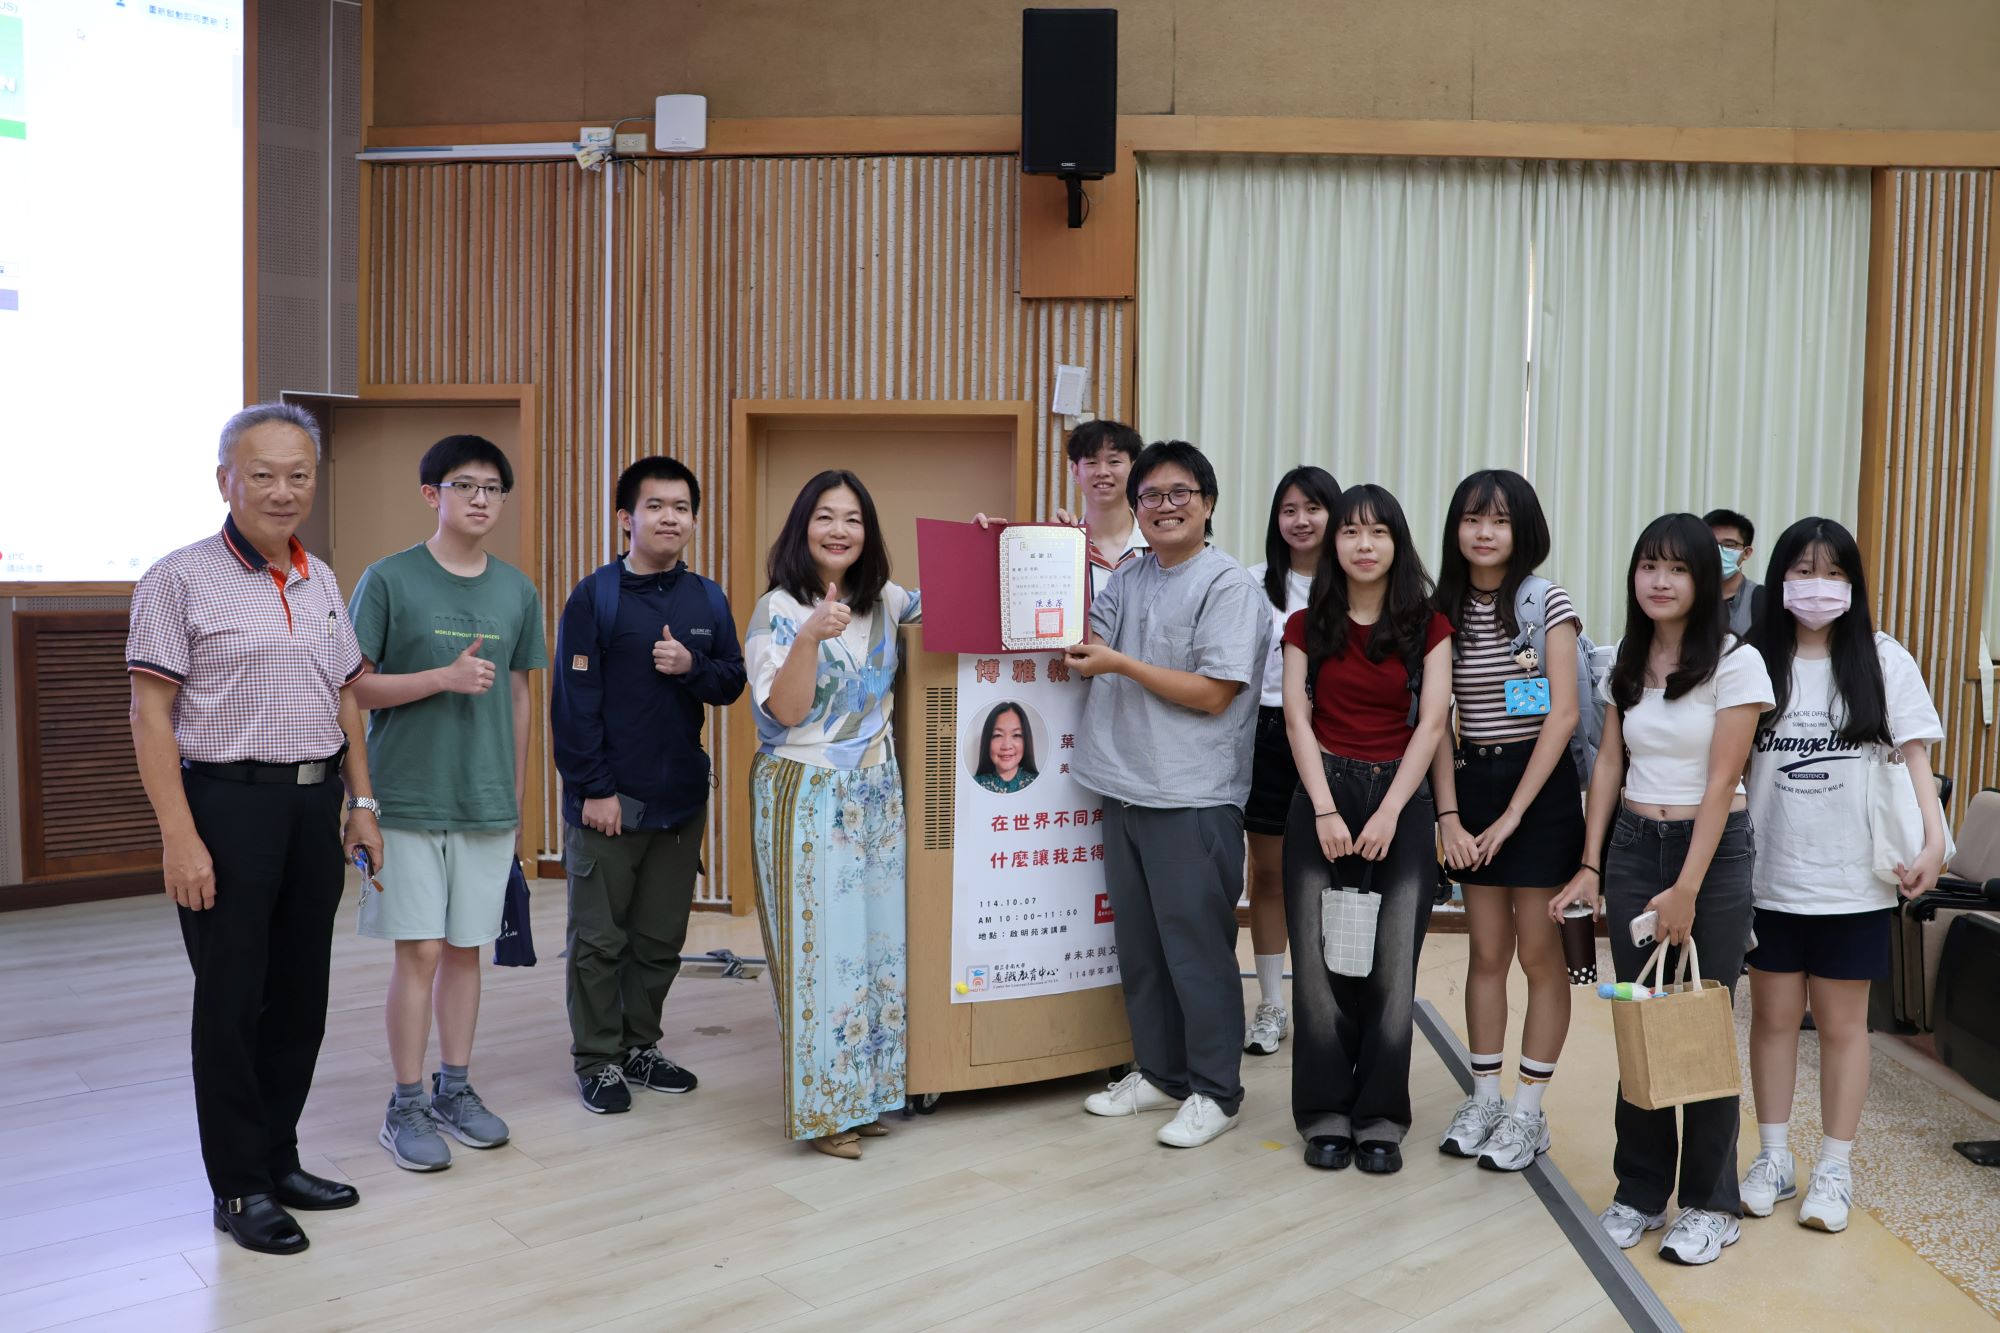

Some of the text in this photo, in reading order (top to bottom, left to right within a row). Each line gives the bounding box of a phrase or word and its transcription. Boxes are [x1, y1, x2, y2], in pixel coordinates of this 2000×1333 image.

[975, 659, 1094, 683] 博雅教
[1060, 734, 1075, 749] 葉
[1060, 763, 1070, 774] 美
[1781, 784, 1794, 793] MORE
[1795, 787, 1822, 795] REWARDING
[991, 808, 1104, 832] 在世界不同角
[990, 844, 1105, 869] 什麼讓我走得
[979, 897, 1037, 908] 114.10.07
[978, 916, 993, 924] AM
